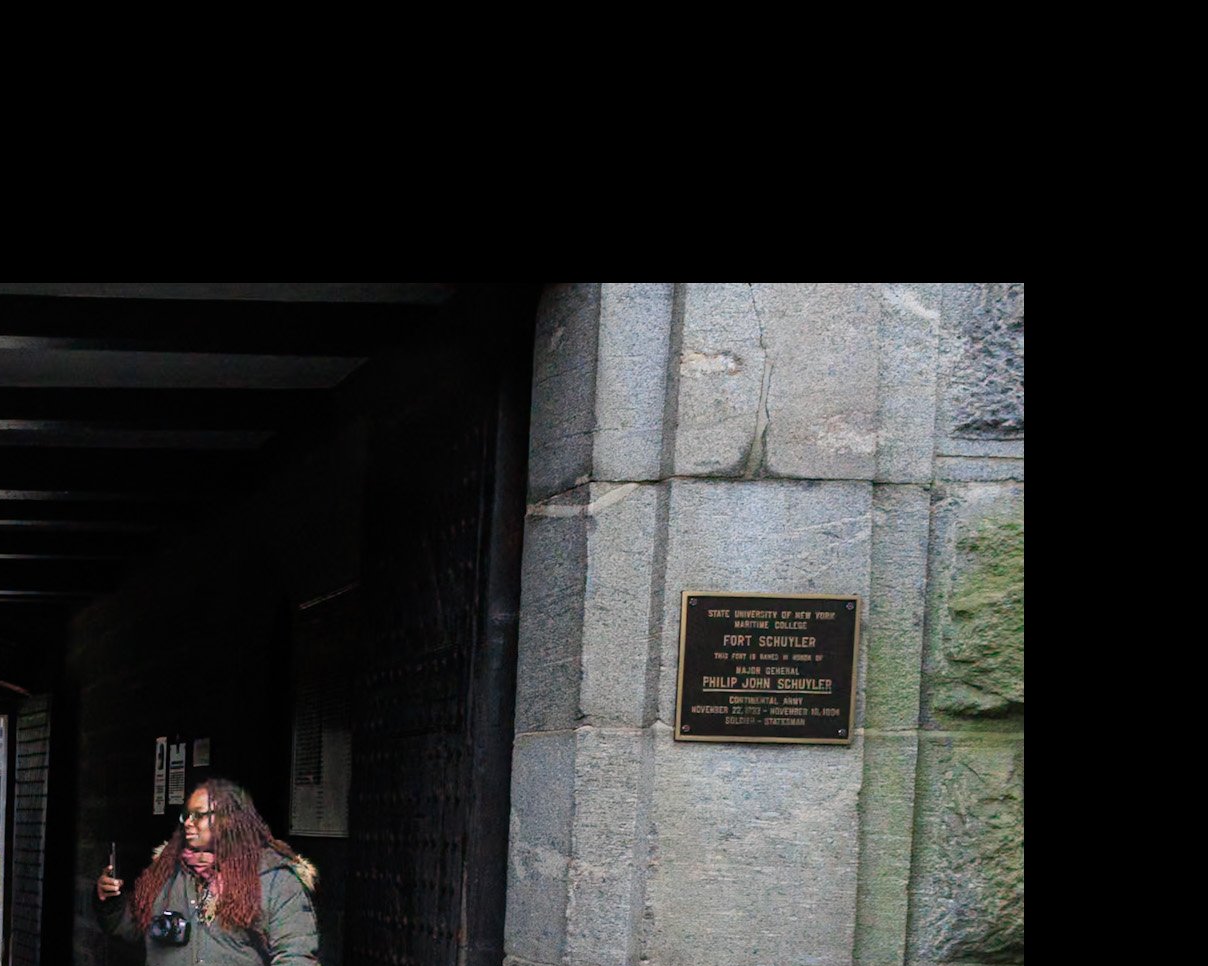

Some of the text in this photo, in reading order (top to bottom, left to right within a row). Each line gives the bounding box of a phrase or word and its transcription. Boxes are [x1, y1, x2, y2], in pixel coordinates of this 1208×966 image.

[708, 610, 730, 618] STATE
[735, 610, 777, 618] UNIVERSITY
[795, 611, 811, 619] NEW
[815, 612, 836, 620] YORK
[734, 621, 807, 630] MARITIME COLLEGE
[723, 635, 816, 648] FORT SCHUYLER
[736, 666, 800, 675] MAJOR GENERAL
[702, 676, 832, 690] PHILIP JOHN SCHUYLER
[729, 697, 803, 705] CONTINENTAL ARMY
[692, 706, 728, 714] NOVEMBER
[770, 707, 808, 716] NOVEMBER
[764, 717, 805, 726] STATESMAN
